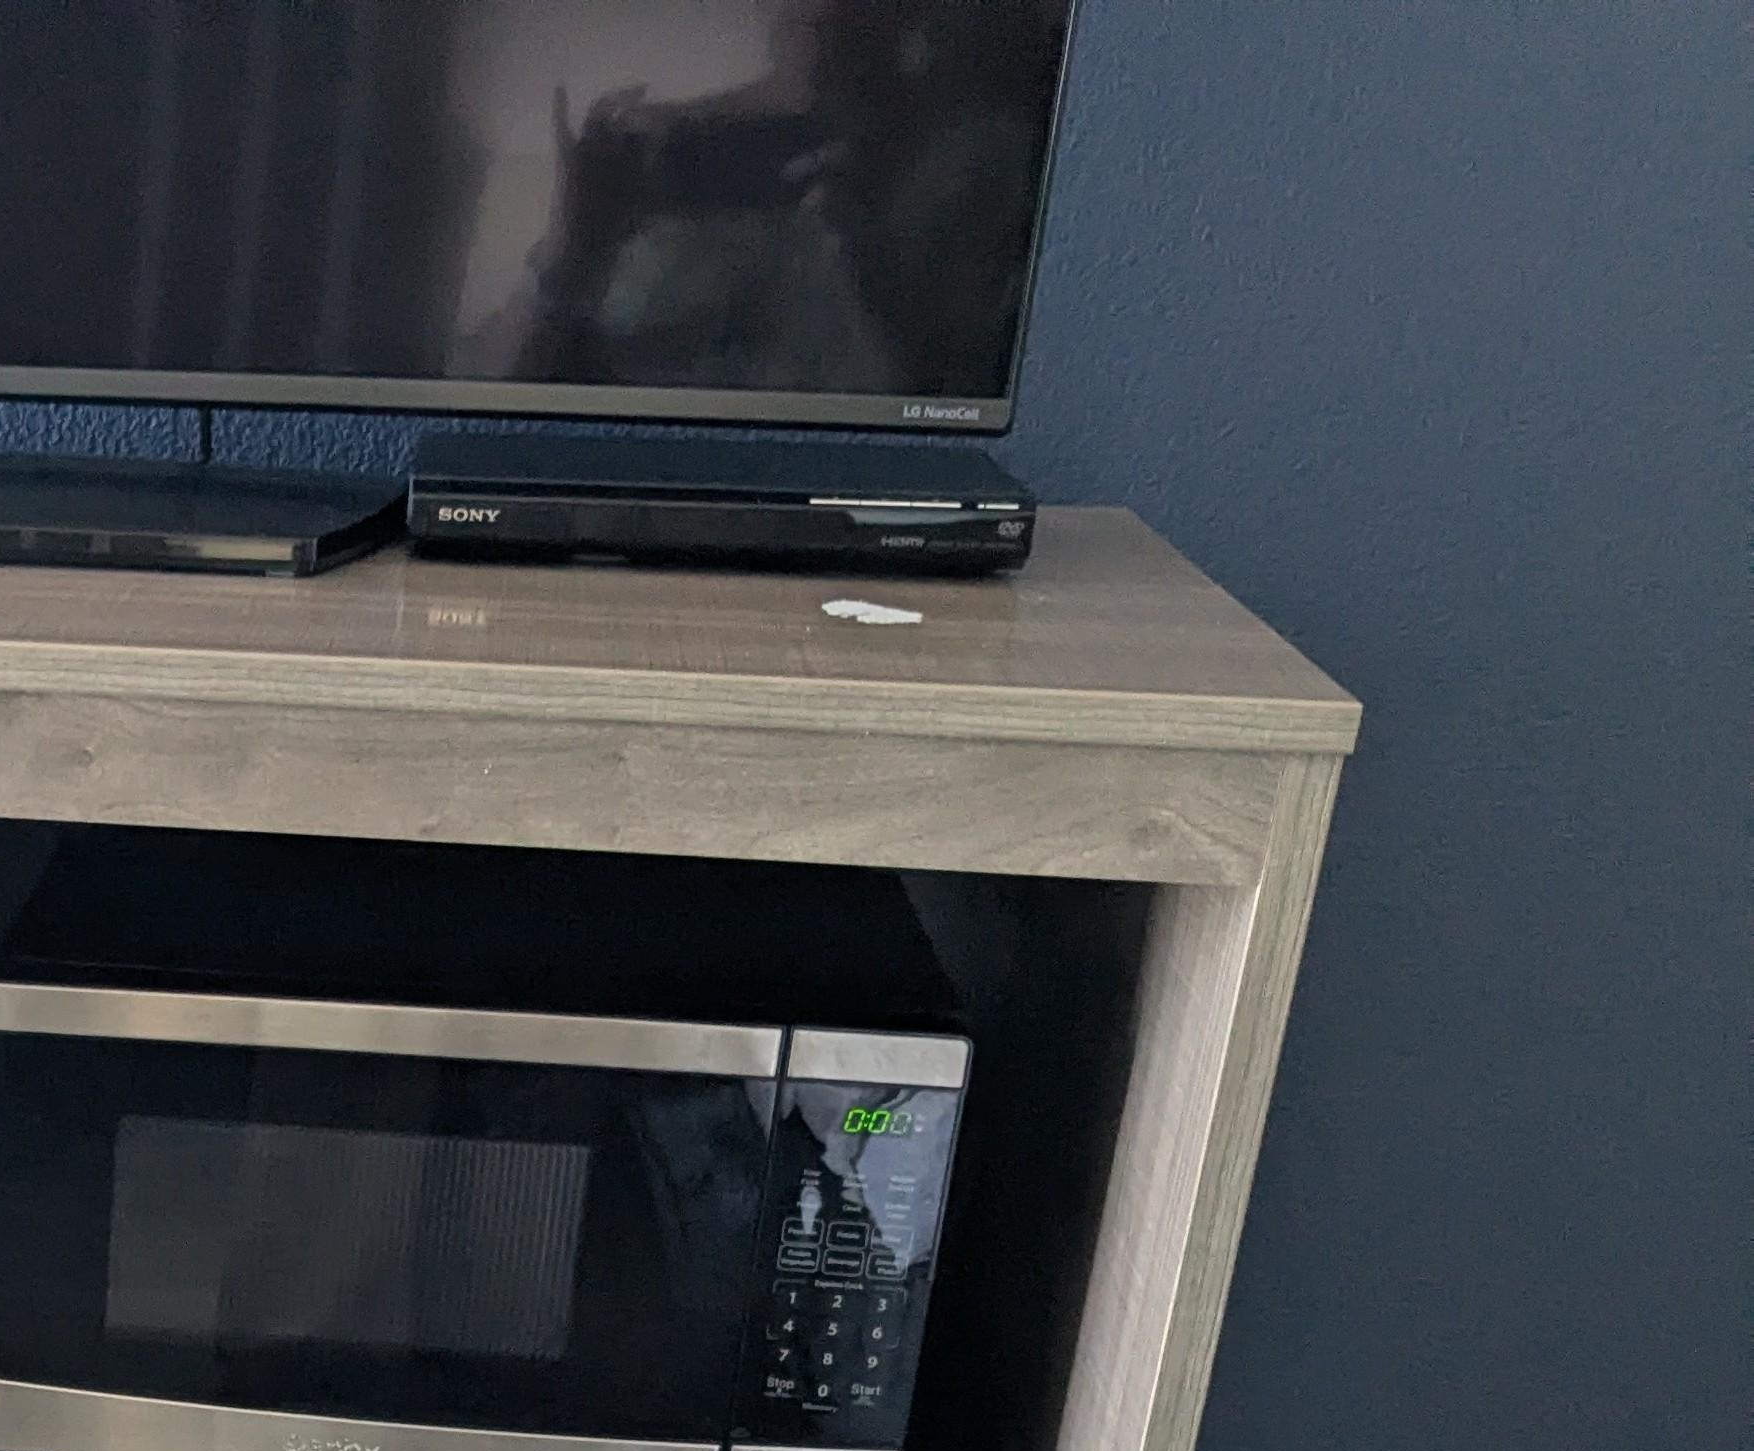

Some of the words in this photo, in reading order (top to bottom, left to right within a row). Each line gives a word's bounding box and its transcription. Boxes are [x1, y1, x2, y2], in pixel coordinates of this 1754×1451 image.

[903, 405, 922, 418] LG
[924, 406, 980, 420] NanoCell
[438, 507, 501, 522] SONY
[789, 1292, 797, 1304] 1
[832, 1295, 843, 1308] 2
[877, 1299, 887, 1311] 3
[783, 1320, 794, 1332] 4
[827, 1322, 838, 1336] 5
[872, 1326, 883, 1339] 6
[778, 1349, 790, 1362] 7
[822, 1352, 833, 1365] 8
[867, 1356, 878, 1369] 9
[766, 1376, 795, 1390] Stop
[850, 1383, 881, 1396] Start
[817, 1384, 829, 1397] 0
